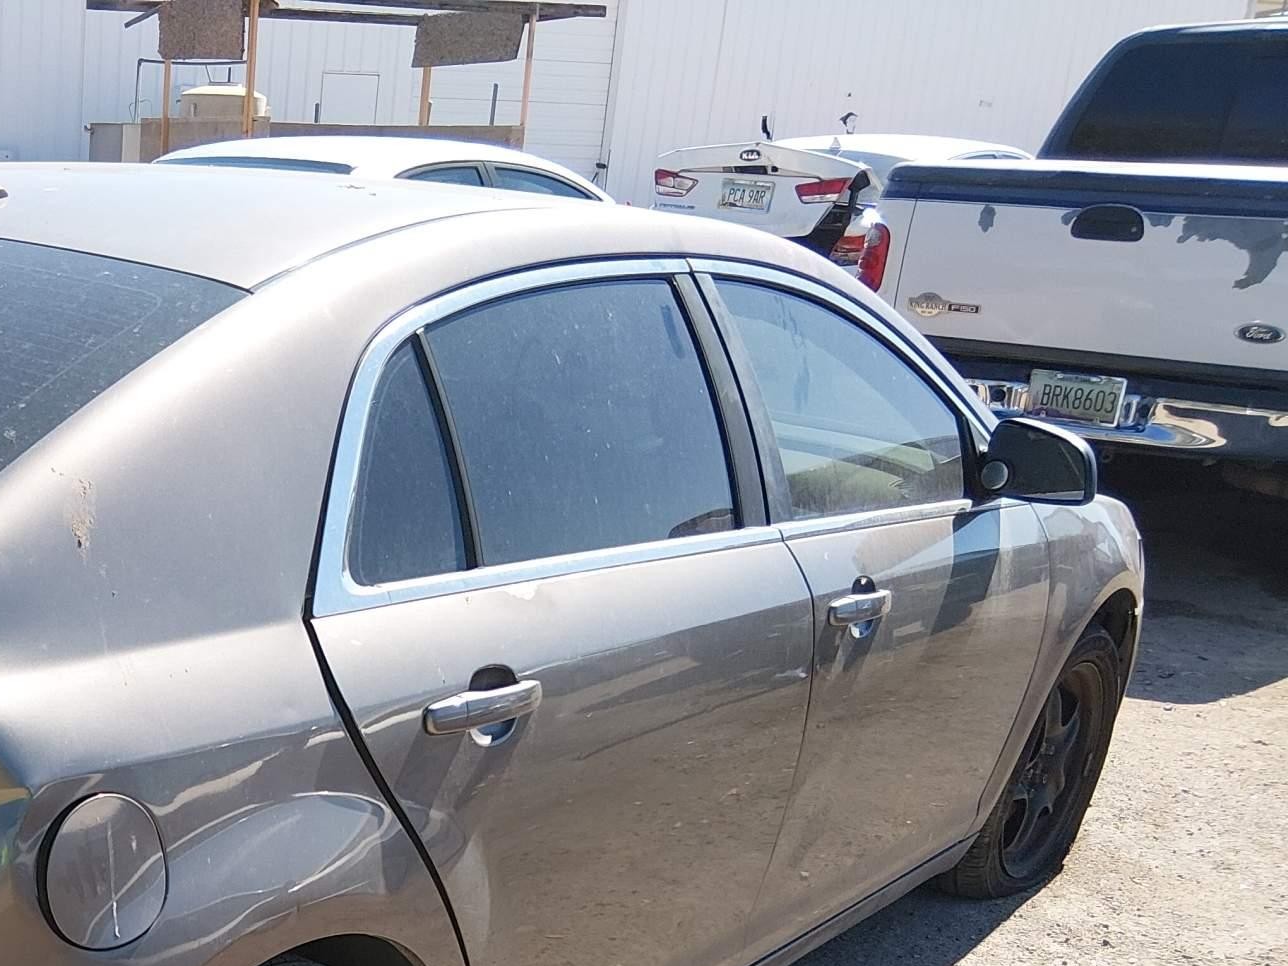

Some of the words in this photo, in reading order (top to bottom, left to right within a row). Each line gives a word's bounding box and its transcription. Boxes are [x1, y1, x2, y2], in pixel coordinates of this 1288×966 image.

[727, 187, 745, 203] PCA
[746, 189, 766, 204] 9AR
[1039, 383, 1118, 414] BRK8603
